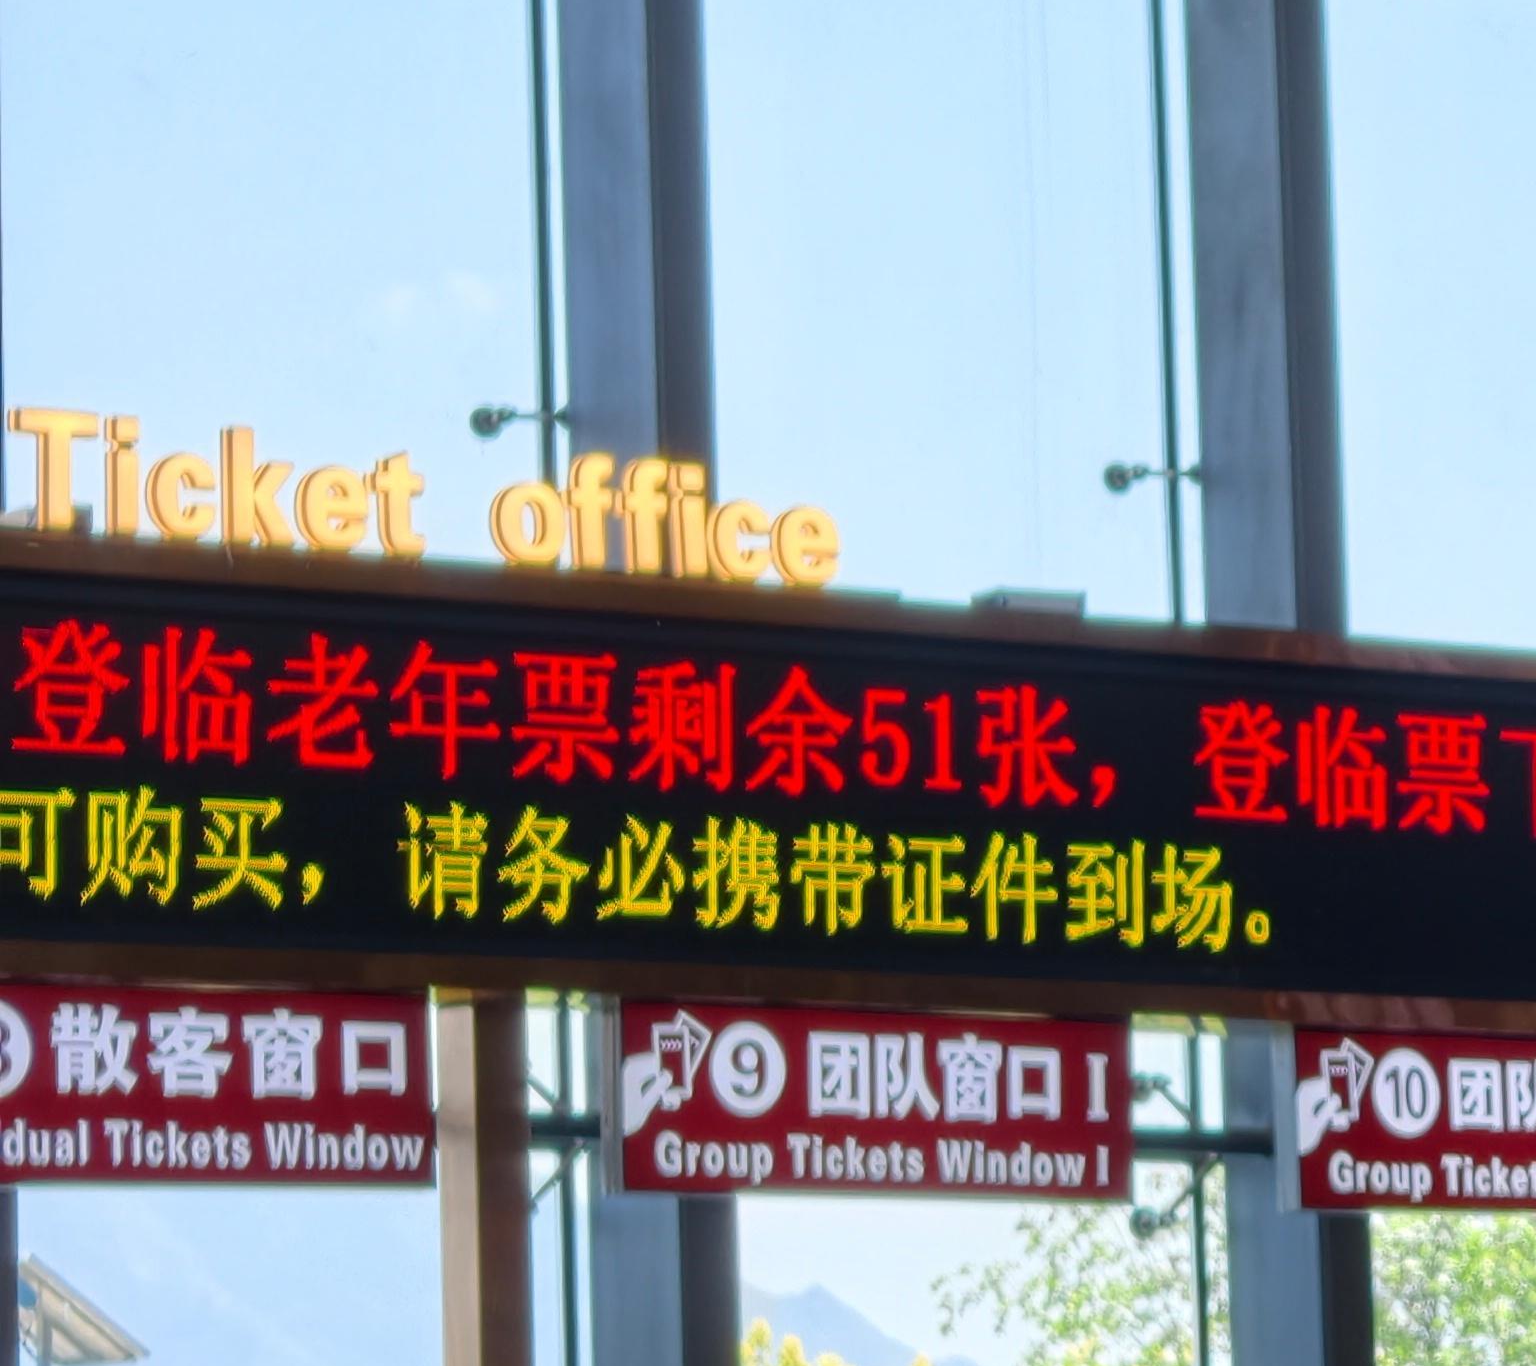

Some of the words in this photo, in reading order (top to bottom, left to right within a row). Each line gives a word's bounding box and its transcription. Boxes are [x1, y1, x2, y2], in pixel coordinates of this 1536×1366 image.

[9, 407, 426, 557] Ticket
[488, 452, 841, 587] office
[50, 1002, 407, 1100] 散客窗口
[807, 1030, 1062, 1123] 团队窗口
[103, 1118, 252, 1169] Tickets
[264, 1122, 425, 1170] Window
[654, 1130, 774, 1187] Group
[787, 1132, 925, 1183] Tickets
[936, 1137, 1087, 1188] Window
[1328, 1150, 1433, 1203] Group
